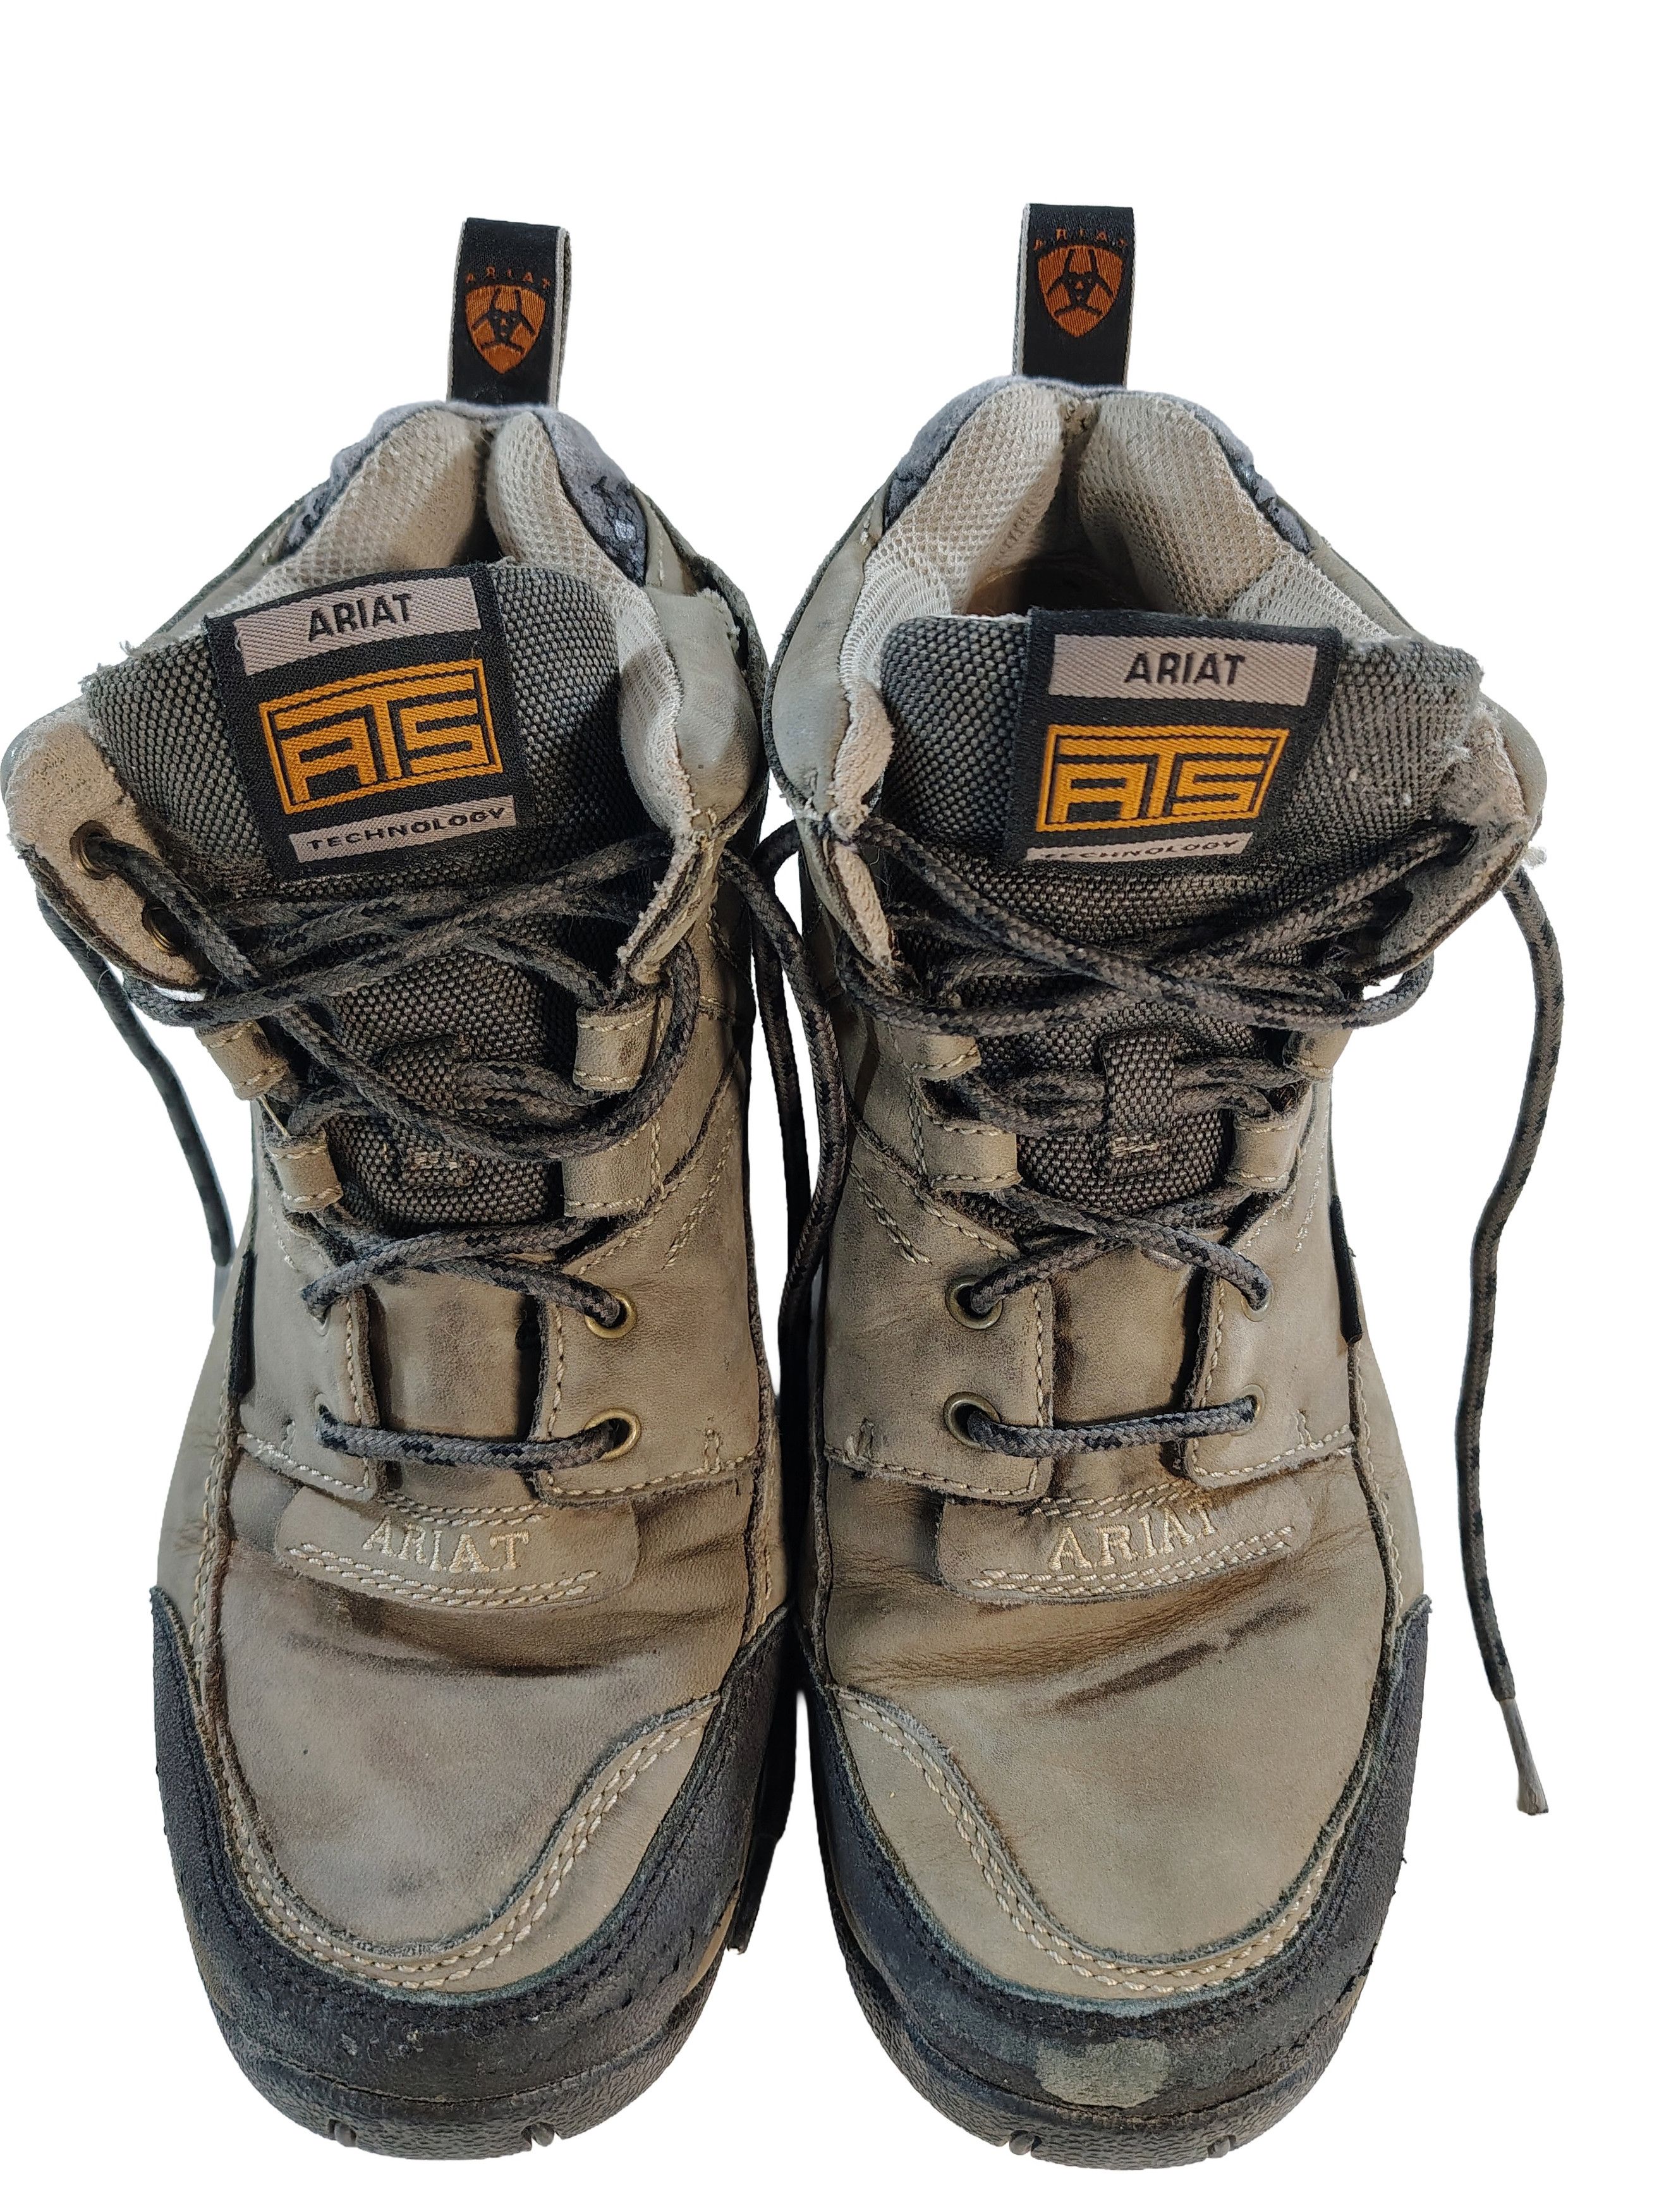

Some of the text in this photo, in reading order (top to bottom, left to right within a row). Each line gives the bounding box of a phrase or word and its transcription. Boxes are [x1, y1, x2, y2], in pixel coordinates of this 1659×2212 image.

[307, 593, 413, 643] ARIAT
[1123, 651, 1246, 686] ARIAT
[272, 672, 490, 803] ATS
[1049, 737, 1275, 823] ATS
[307, 806, 506, 851] TECHNOLOGY
[1040, 839, 1240, 860] TECHNOLOGY
[362, 1514, 530, 1573] ARIAT
[1047, 1499, 1218, 1571] ARIAT
